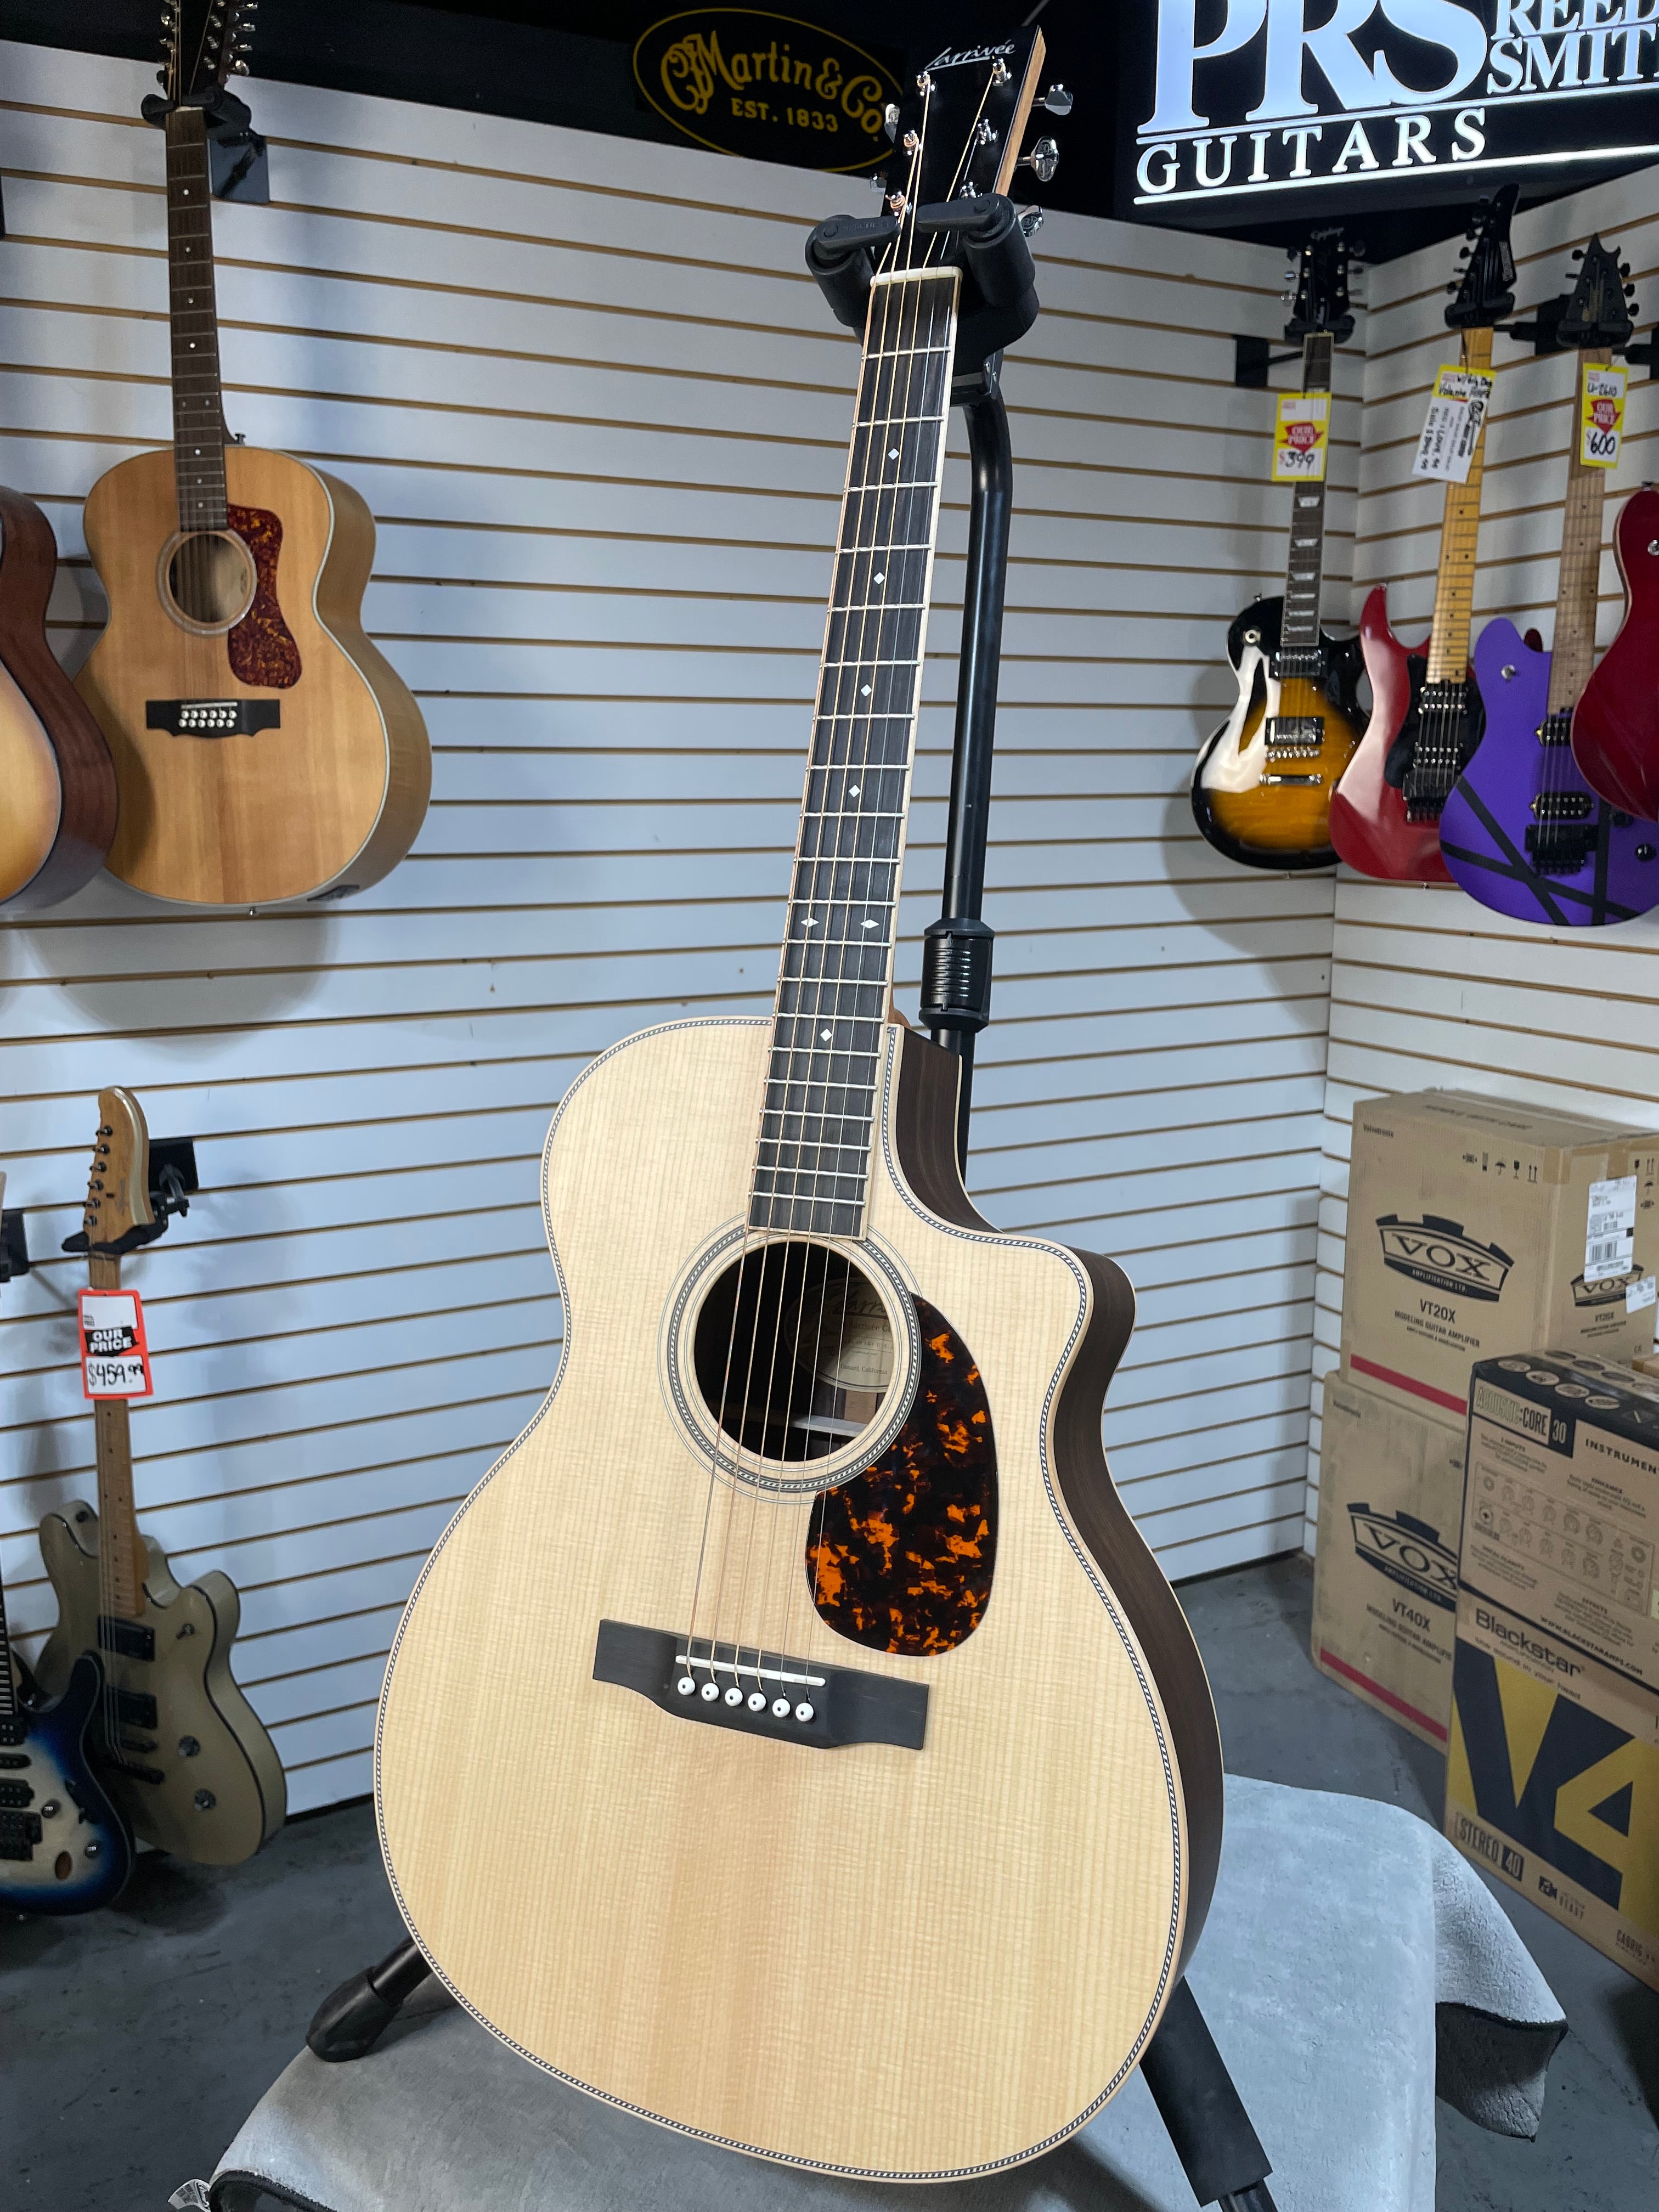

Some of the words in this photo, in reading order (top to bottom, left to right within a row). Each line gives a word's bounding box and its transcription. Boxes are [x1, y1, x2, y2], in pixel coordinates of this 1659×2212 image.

[1137, 0, 1487, 134] PRS
[1487, 23, 1659, 94] SMIT
[786, 107, 839, 132] 1833
[1136, 108, 1486, 194] GUITARS
[1391, 1233, 1491, 1282] VOX
[1419, 1298, 1457, 1324] VT20X
[90, 1336, 132, 1353] PRICE
[93, 1329, 123, 1342] OUR
[861, 1366, 888, 1375] California
[1552, 1419, 1567, 1444] 30
[1585, 1438, 1659, 1475] INSTRUMEN
[1392, 1597, 1431, 1633] VT40X
[1475, 1607, 1582, 1677] Blackstar
[1459, 1816, 1499, 1863] STEREO
[1504, 1848, 1522, 1878] 40
